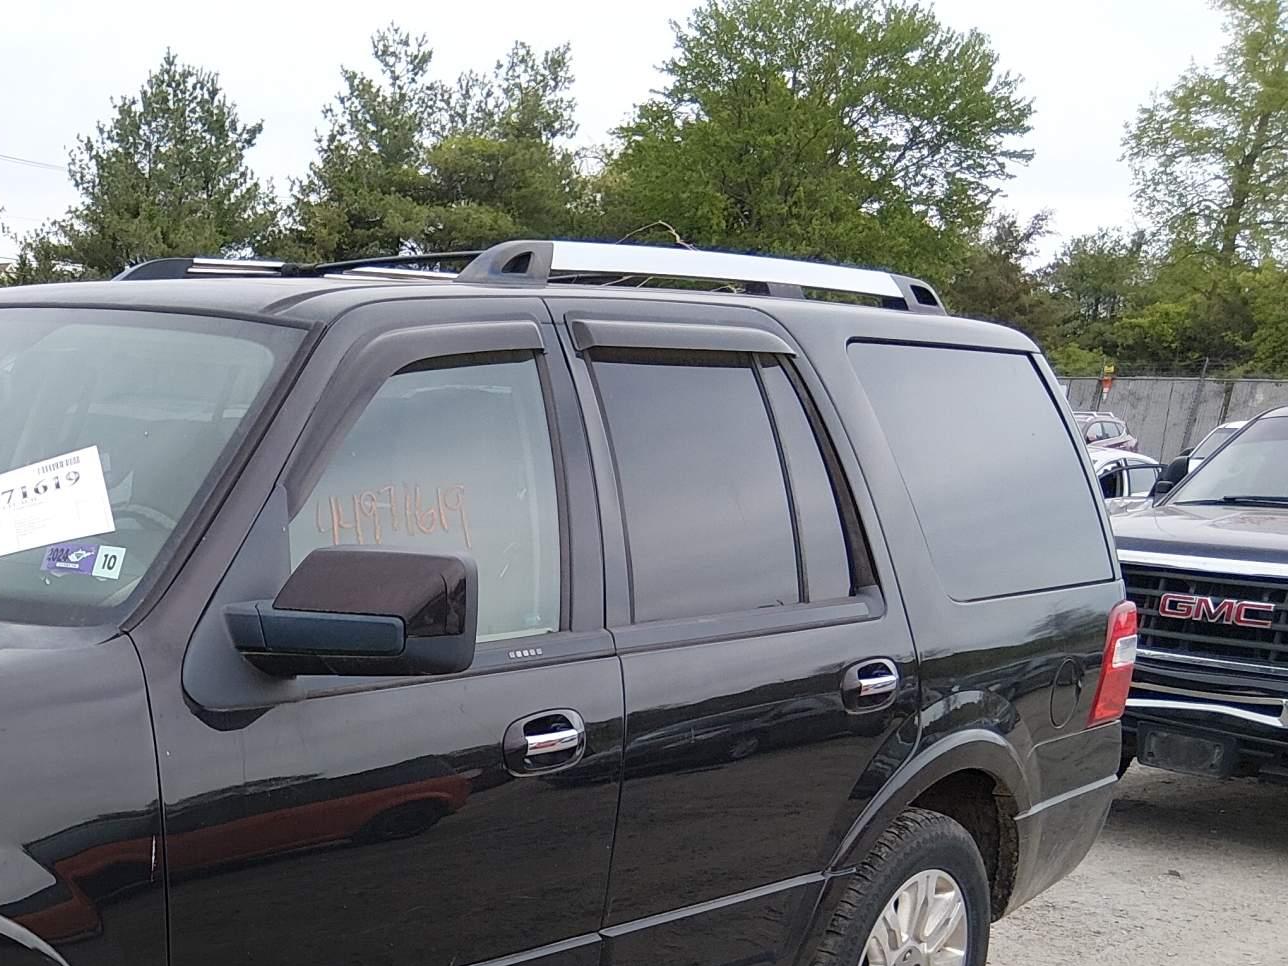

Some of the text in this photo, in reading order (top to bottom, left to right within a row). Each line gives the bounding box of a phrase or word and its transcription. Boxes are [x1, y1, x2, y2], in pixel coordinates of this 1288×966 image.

[317, 481, 473, 549] 44971619
[101, 553, 118, 571] 10
[1159, 593, 1276, 629] GMC
